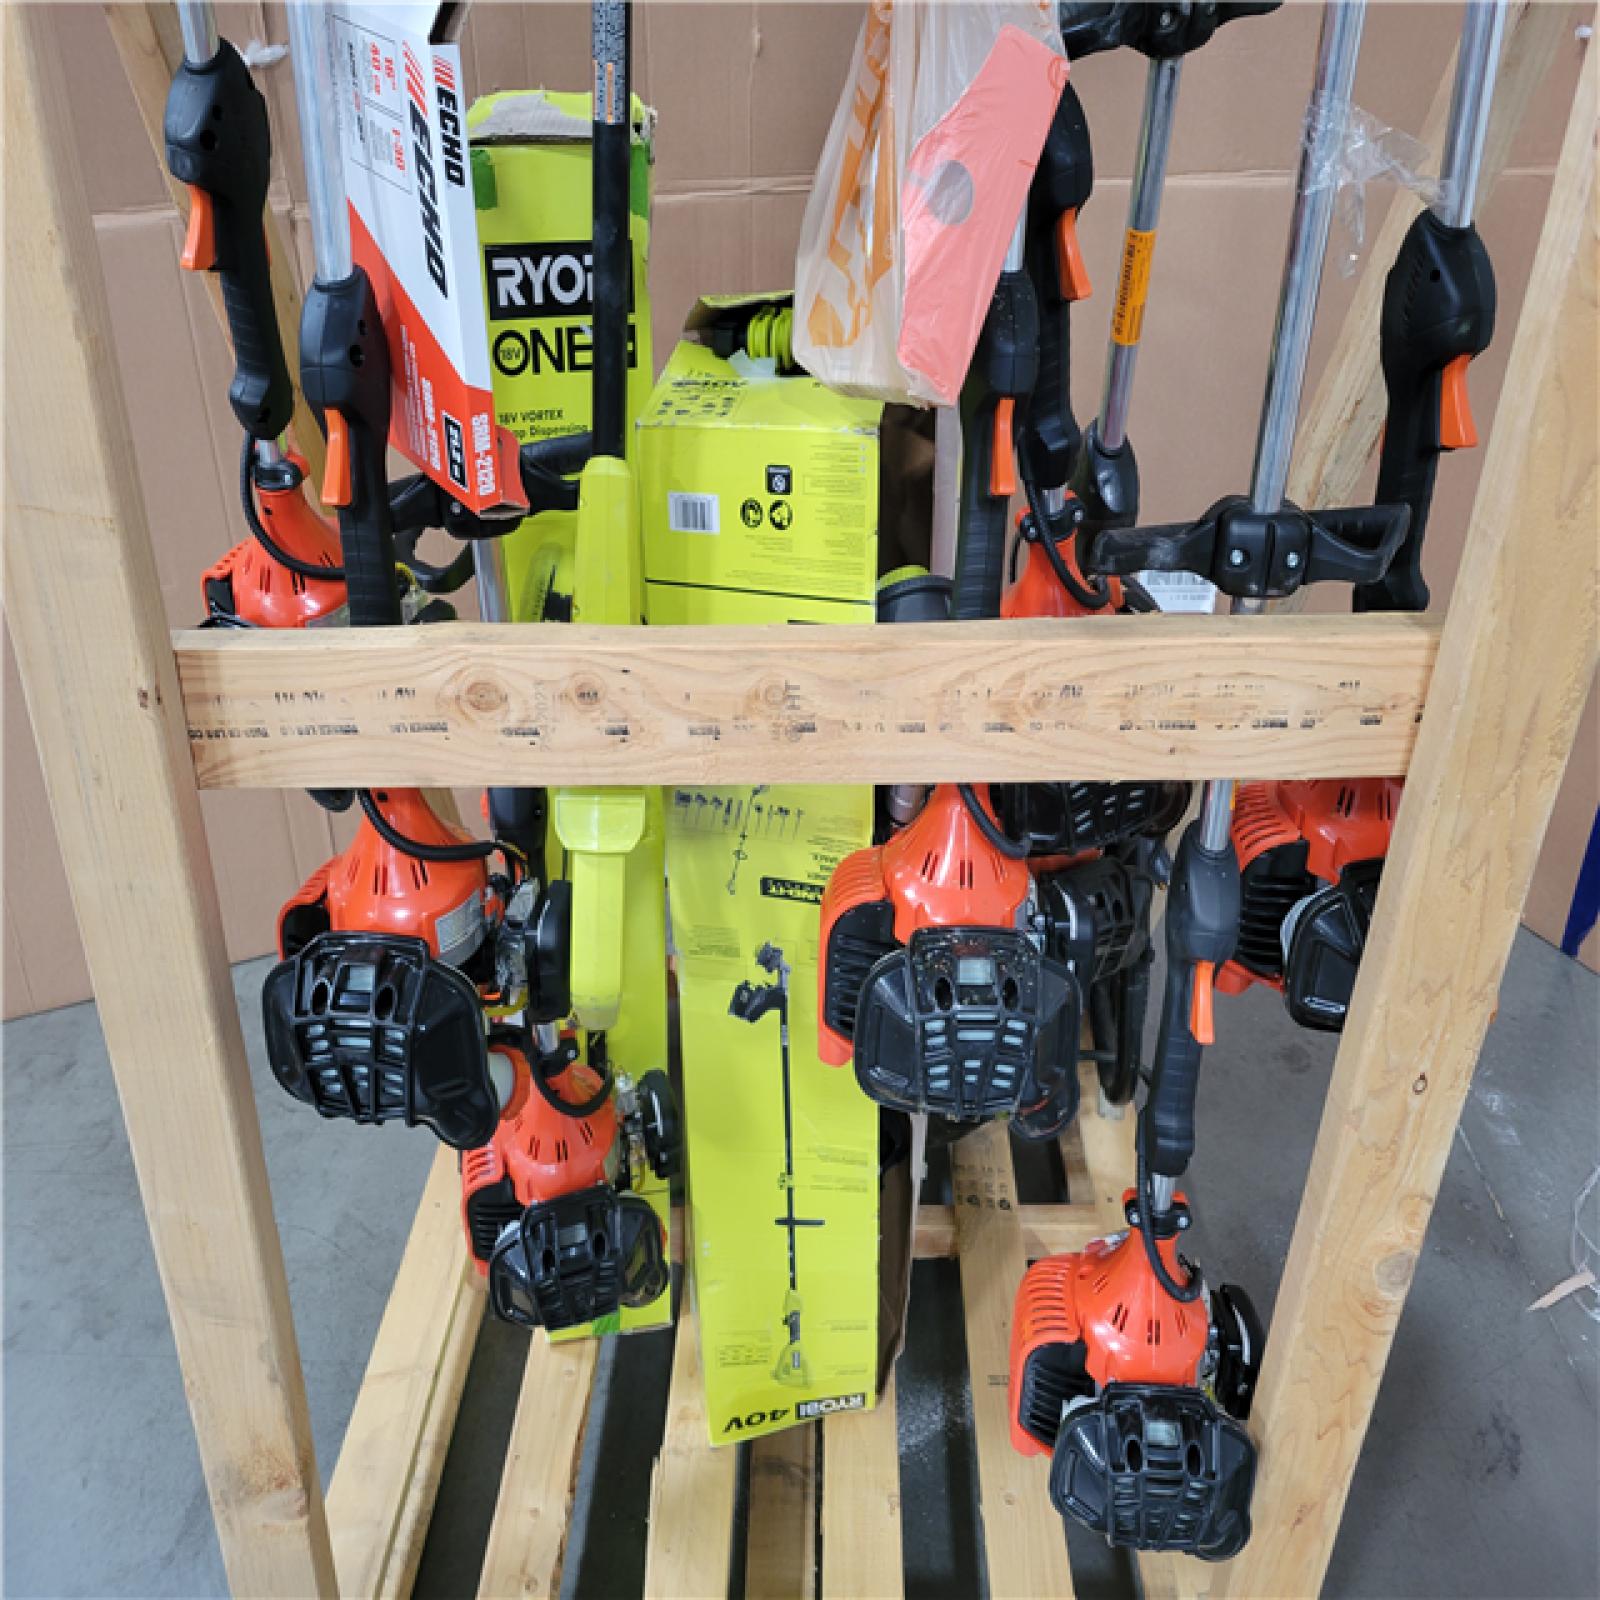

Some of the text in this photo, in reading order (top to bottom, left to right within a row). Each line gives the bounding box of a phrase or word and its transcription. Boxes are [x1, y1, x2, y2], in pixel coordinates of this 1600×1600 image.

[436, 86, 466, 188] ECHO
[409, 100, 448, 298] ECHO
[491, 254, 593, 307] RYO
[500, 347, 521, 361] 18V
[520, 409, 563, 422] VORTEX
[529, 422, 588, 439] Dispensing
[723, 1393, 864, 1433] RYOBI 40V
